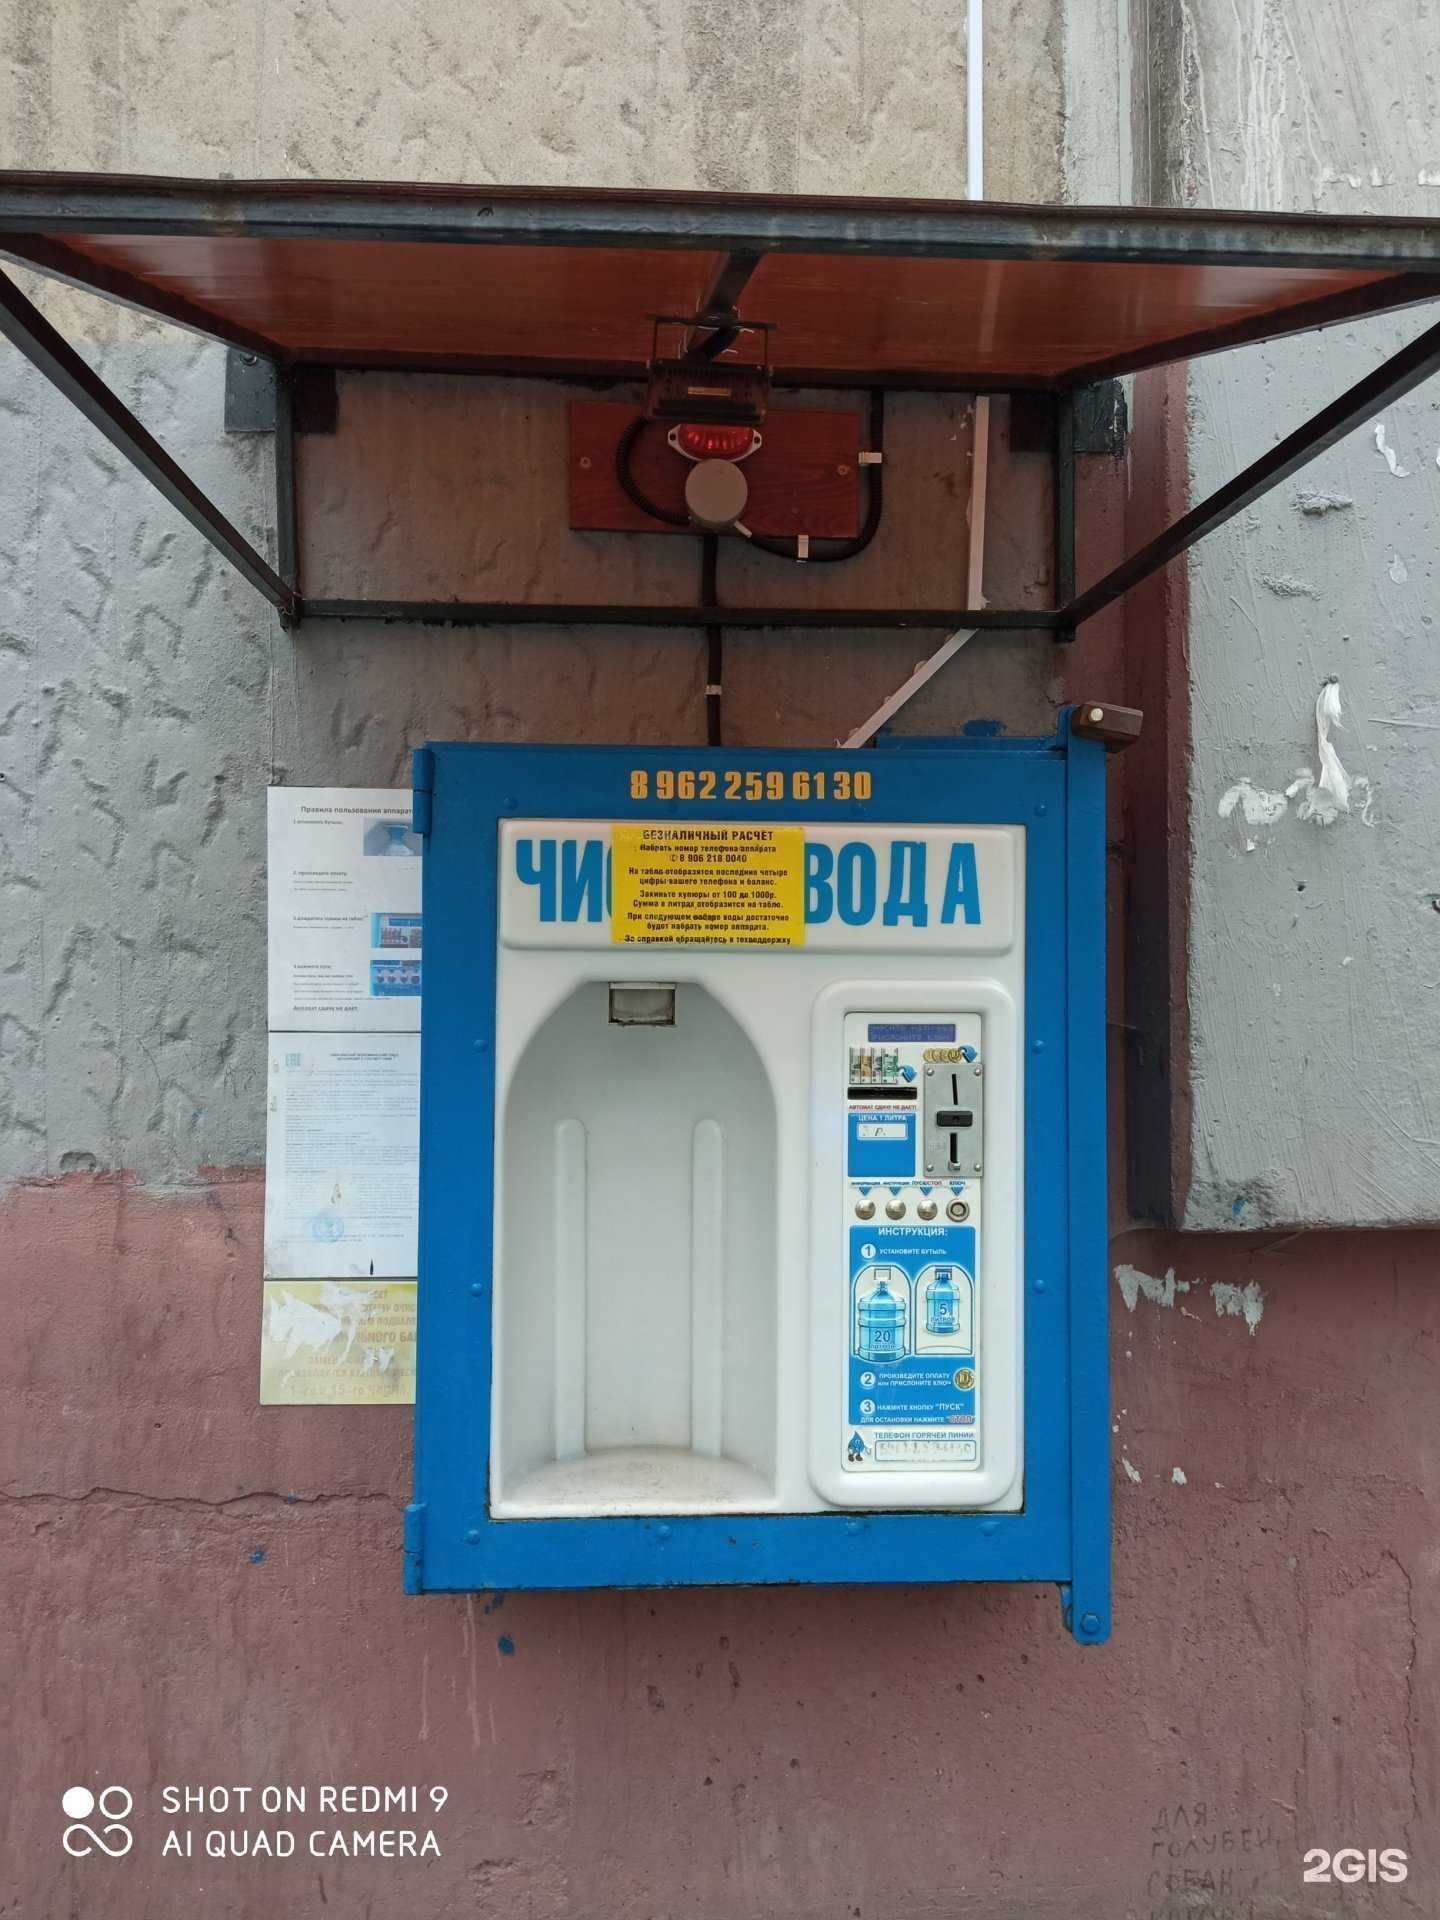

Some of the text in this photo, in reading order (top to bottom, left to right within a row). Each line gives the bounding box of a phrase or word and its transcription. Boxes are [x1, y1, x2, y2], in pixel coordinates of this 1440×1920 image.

[630, 770, 872, 800] 8 962 259 61 30
[643, 829, 728, 841] БЕЗНАЛИЧНЫЙ
[640, 843, 776, 853] Набрать номер телефона аппарата
[628, 866, 639, 875] На
[760, 869, 788, 877] четыре
[516, 839, 612, 923] ЧИ
[639, 878, 666, 886] цифры
[700, 878, 738, 887] телефона
[639, 889, 676, 898] Закиньте
[678, 890, 710, 898] купюры
[723, 890, 737, 898] 100
[739, 891, 749, 899] до
[633, 899, 659, 908] Сумма
[627, 912, 642, 921] При
[644, 913, 692, 921] следующем
[745, 914, 789, 922] достаточно
[647, 922, 669, 931] будет
[671, 923, 702, 931] набрать
[704, 923, 729, 931] номер
[675, 935, 727, 944] обращайтесь
[878, 1227, 948, 1238] ИНСТРУКЦИЯ:
[864, 1245, 871, 1257] 1
[939, 1303, 948, 1316] 5
[873, 1330, 891, 1343] 20
[863, 1373, 873, 1385] 2
[879, 1372, 924, 1380] ПРОИЗВЕДИТЕ
[863, 1401, 872, 1413] 3
[860, 1416, 873, 1424] ДЛЯ
[874, 1416, 913, 1424] ОСТАНОВКИ
[913, 1416, 945, 1424] НАЖМИТЕ
[874, 1431, 911, 1440] ТЕЛЕФОН
[911, 1431, 947, 1440] ГОРЯЧЕЙ
